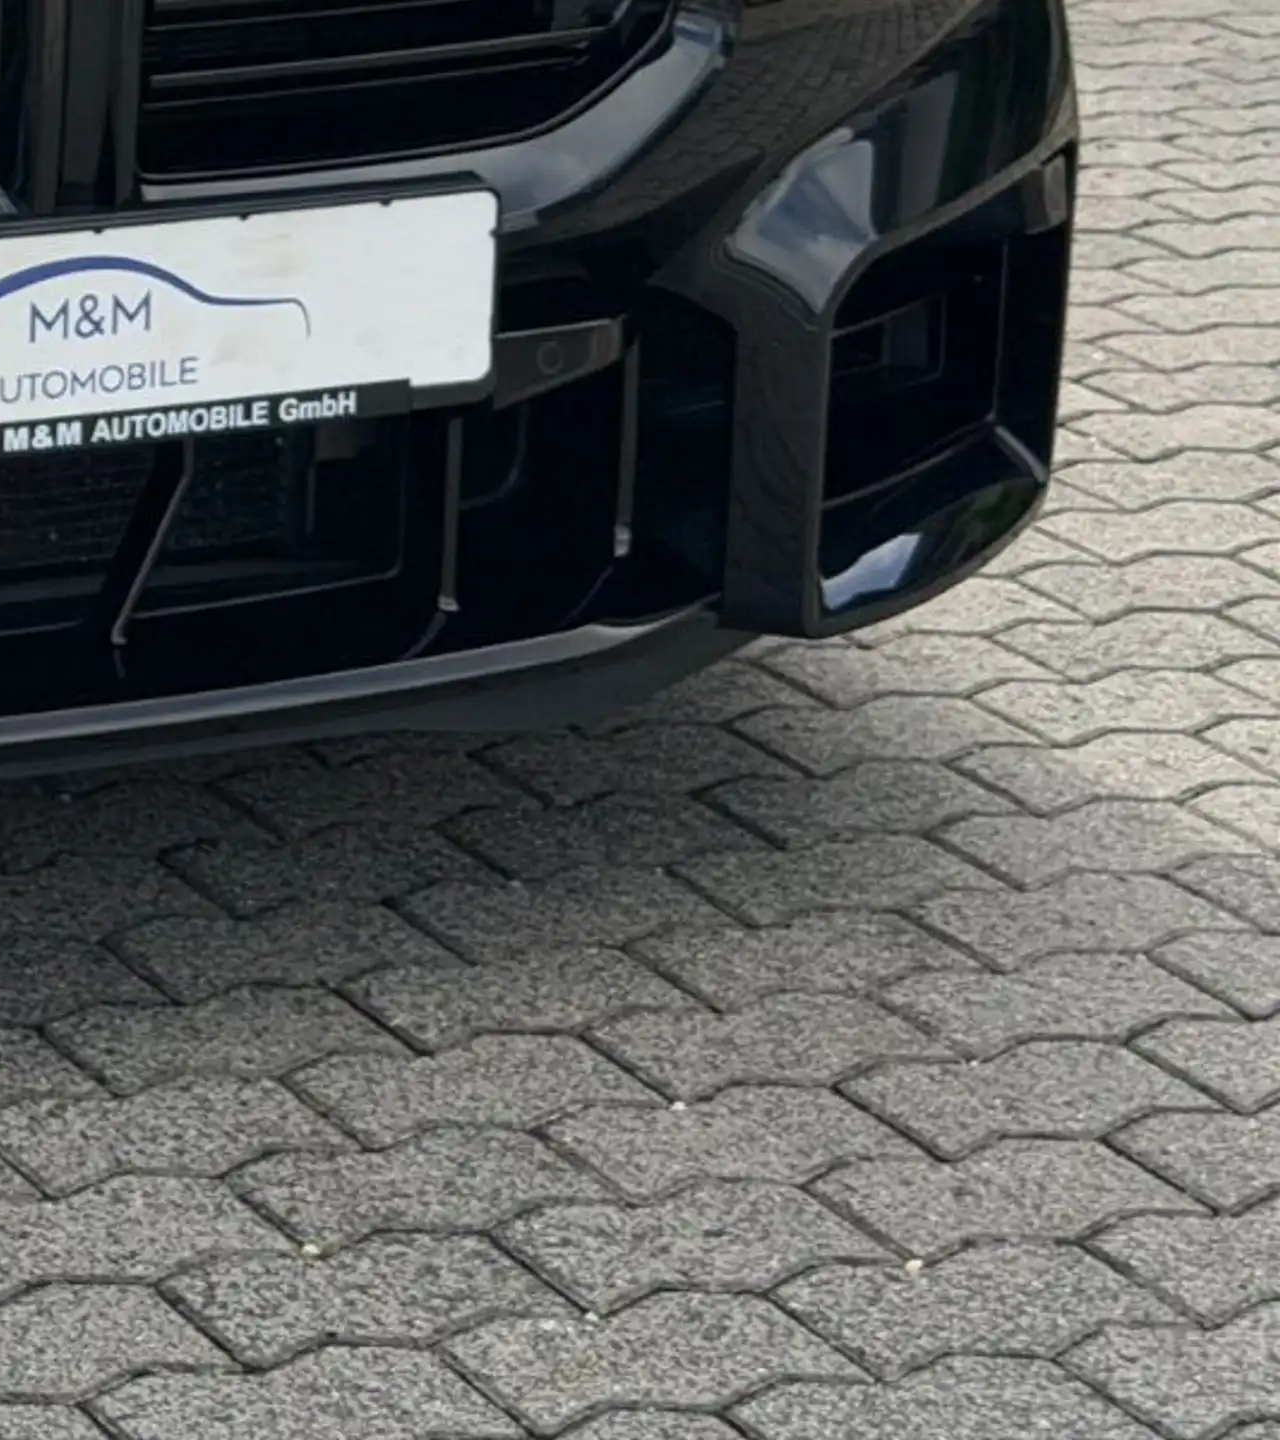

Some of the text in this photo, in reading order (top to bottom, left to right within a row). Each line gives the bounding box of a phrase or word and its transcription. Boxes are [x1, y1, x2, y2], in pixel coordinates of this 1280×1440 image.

[28, 288, 152, 344] M&M
[2, 420, 84, 453] M&M
[90, 400, 271, 443] AUTOMOBILE
[278, 390, 358, 423] GmbH
